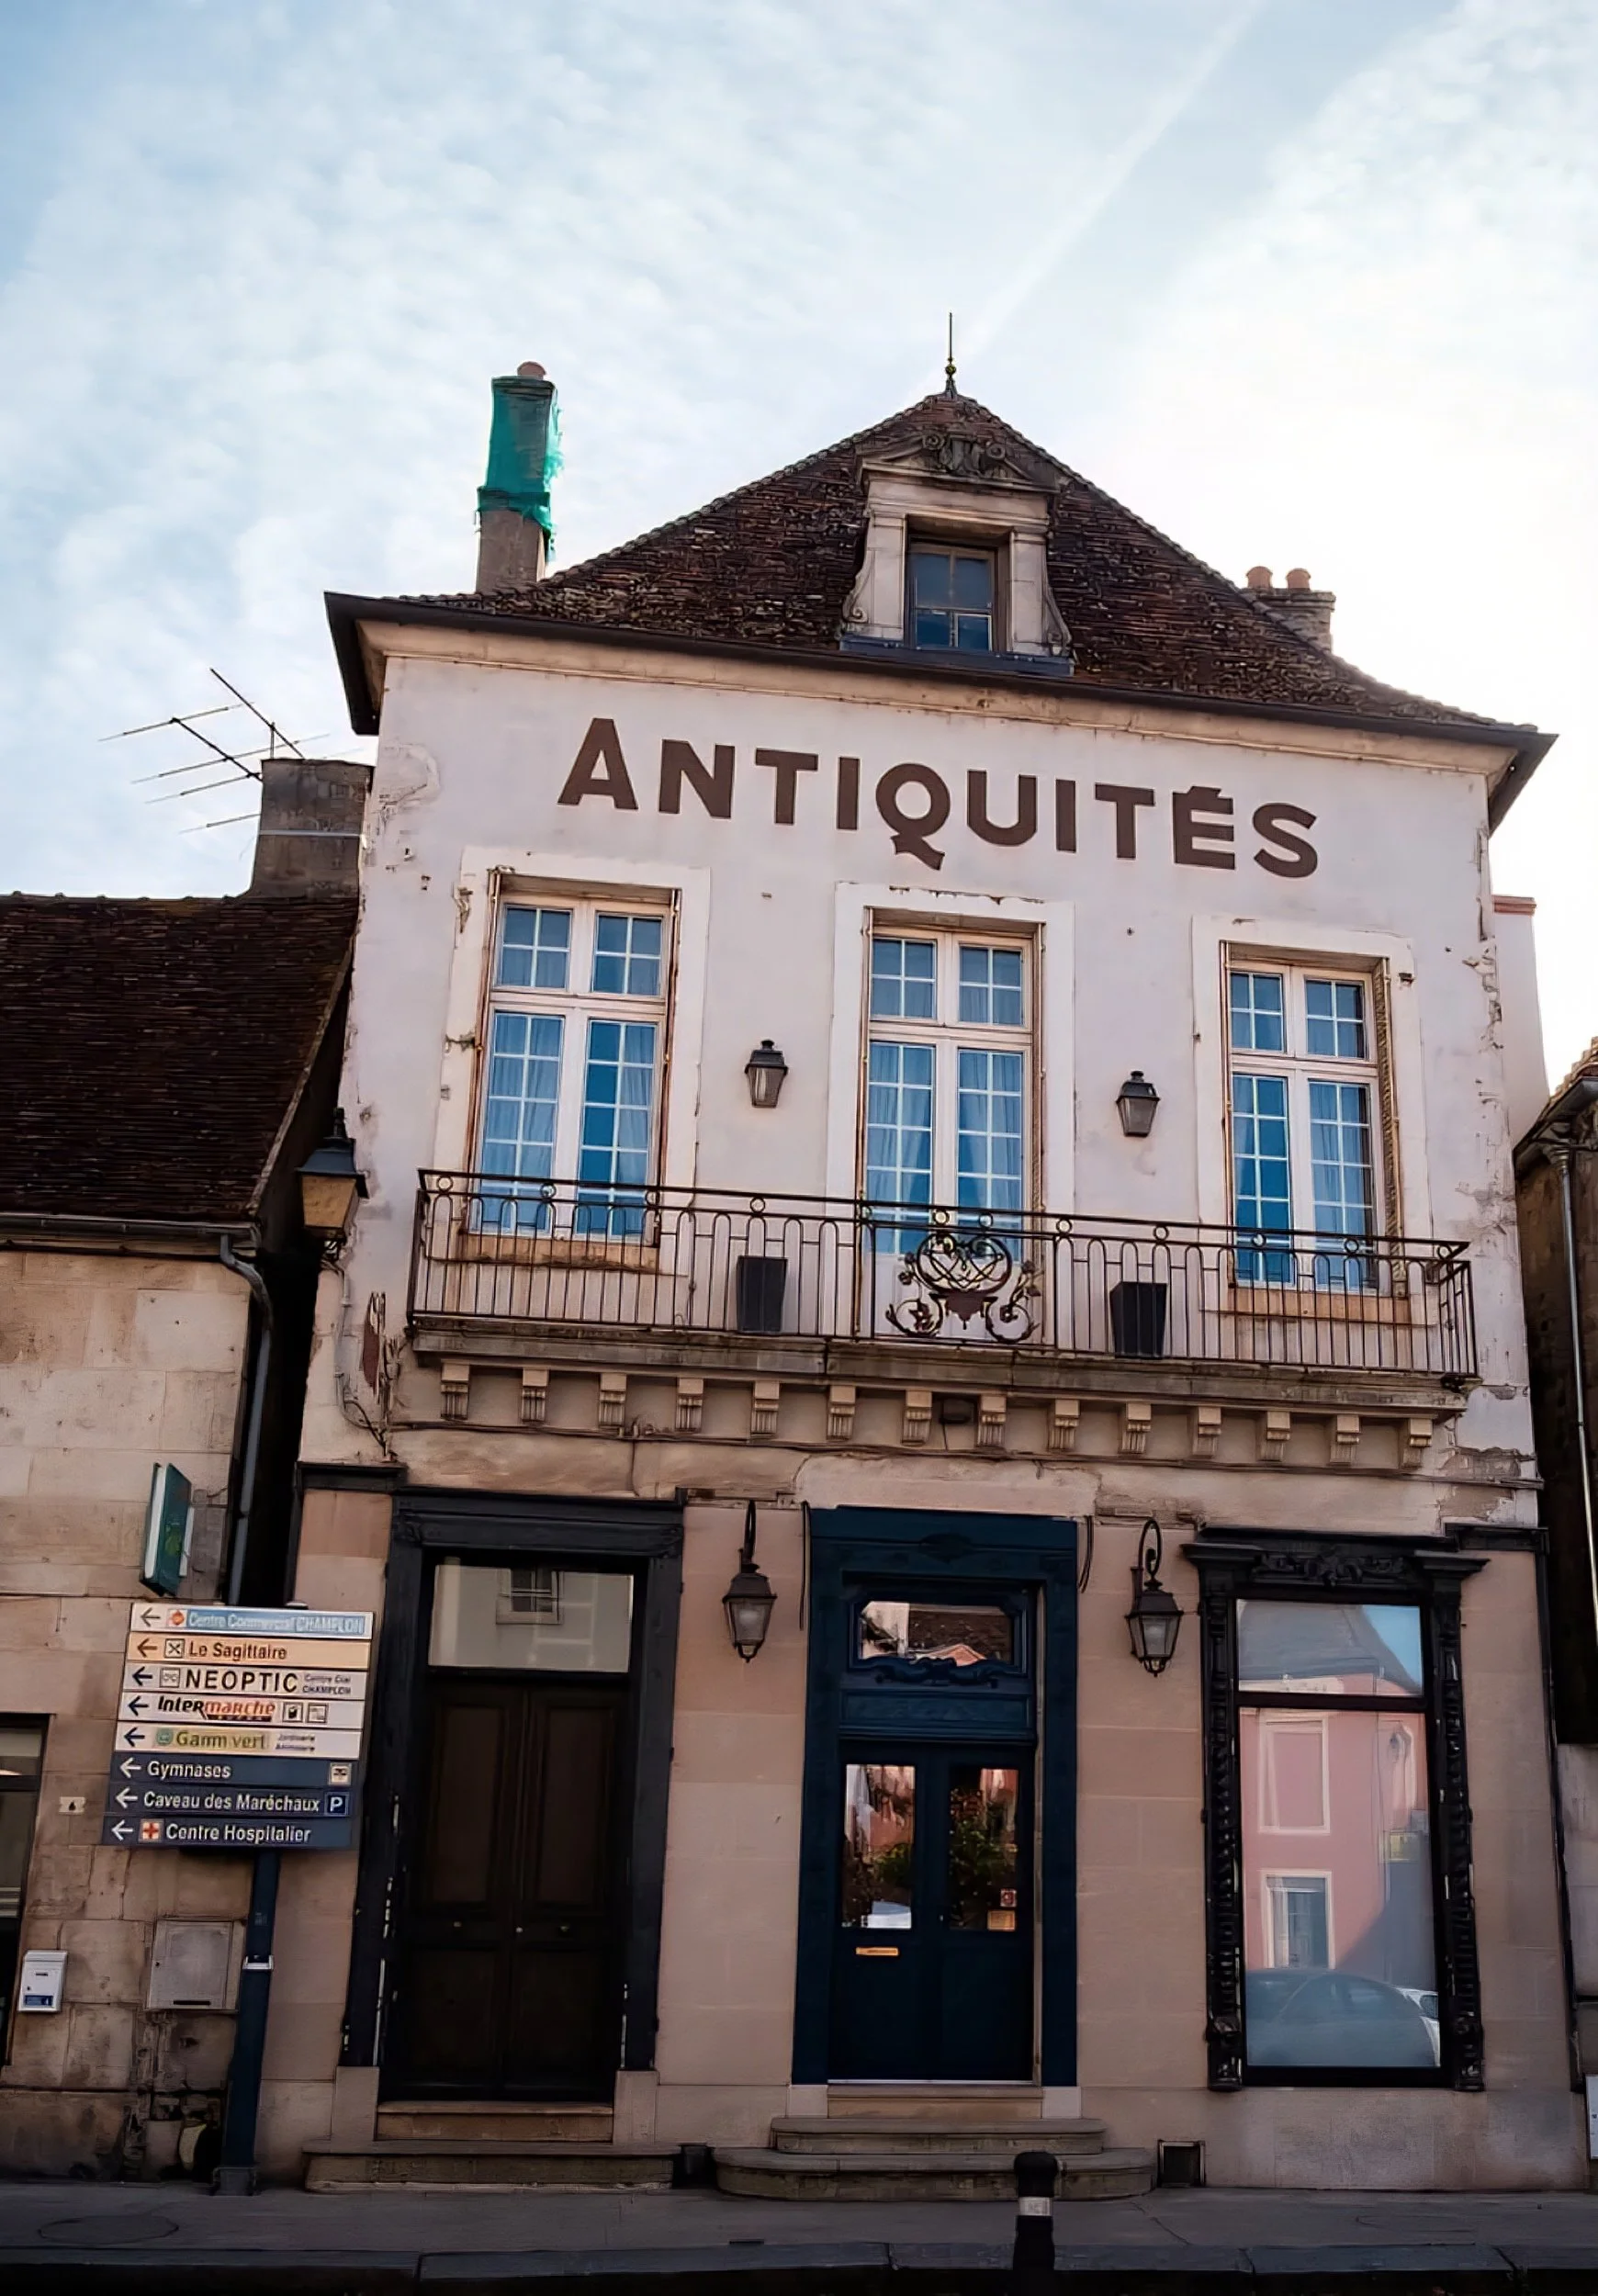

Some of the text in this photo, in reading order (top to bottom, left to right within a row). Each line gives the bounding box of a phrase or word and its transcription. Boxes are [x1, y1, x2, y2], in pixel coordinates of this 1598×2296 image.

[557, 717, 1319, 879] ANTIQUITÉS
[189, 1642, 287, 1661] Le Sagittaire
[186, 1669, 298, 1693] NEOPTIC
[232, 1733, 265, 1750] vert
[147, 1760, 231, 1781] Gymnases
[143, 1791, 320, 1812] Caveau des Maréchaux
[330, 1796, 343, 1812] P
[166, 1823, 311, 1845] Centre Hospitalier
